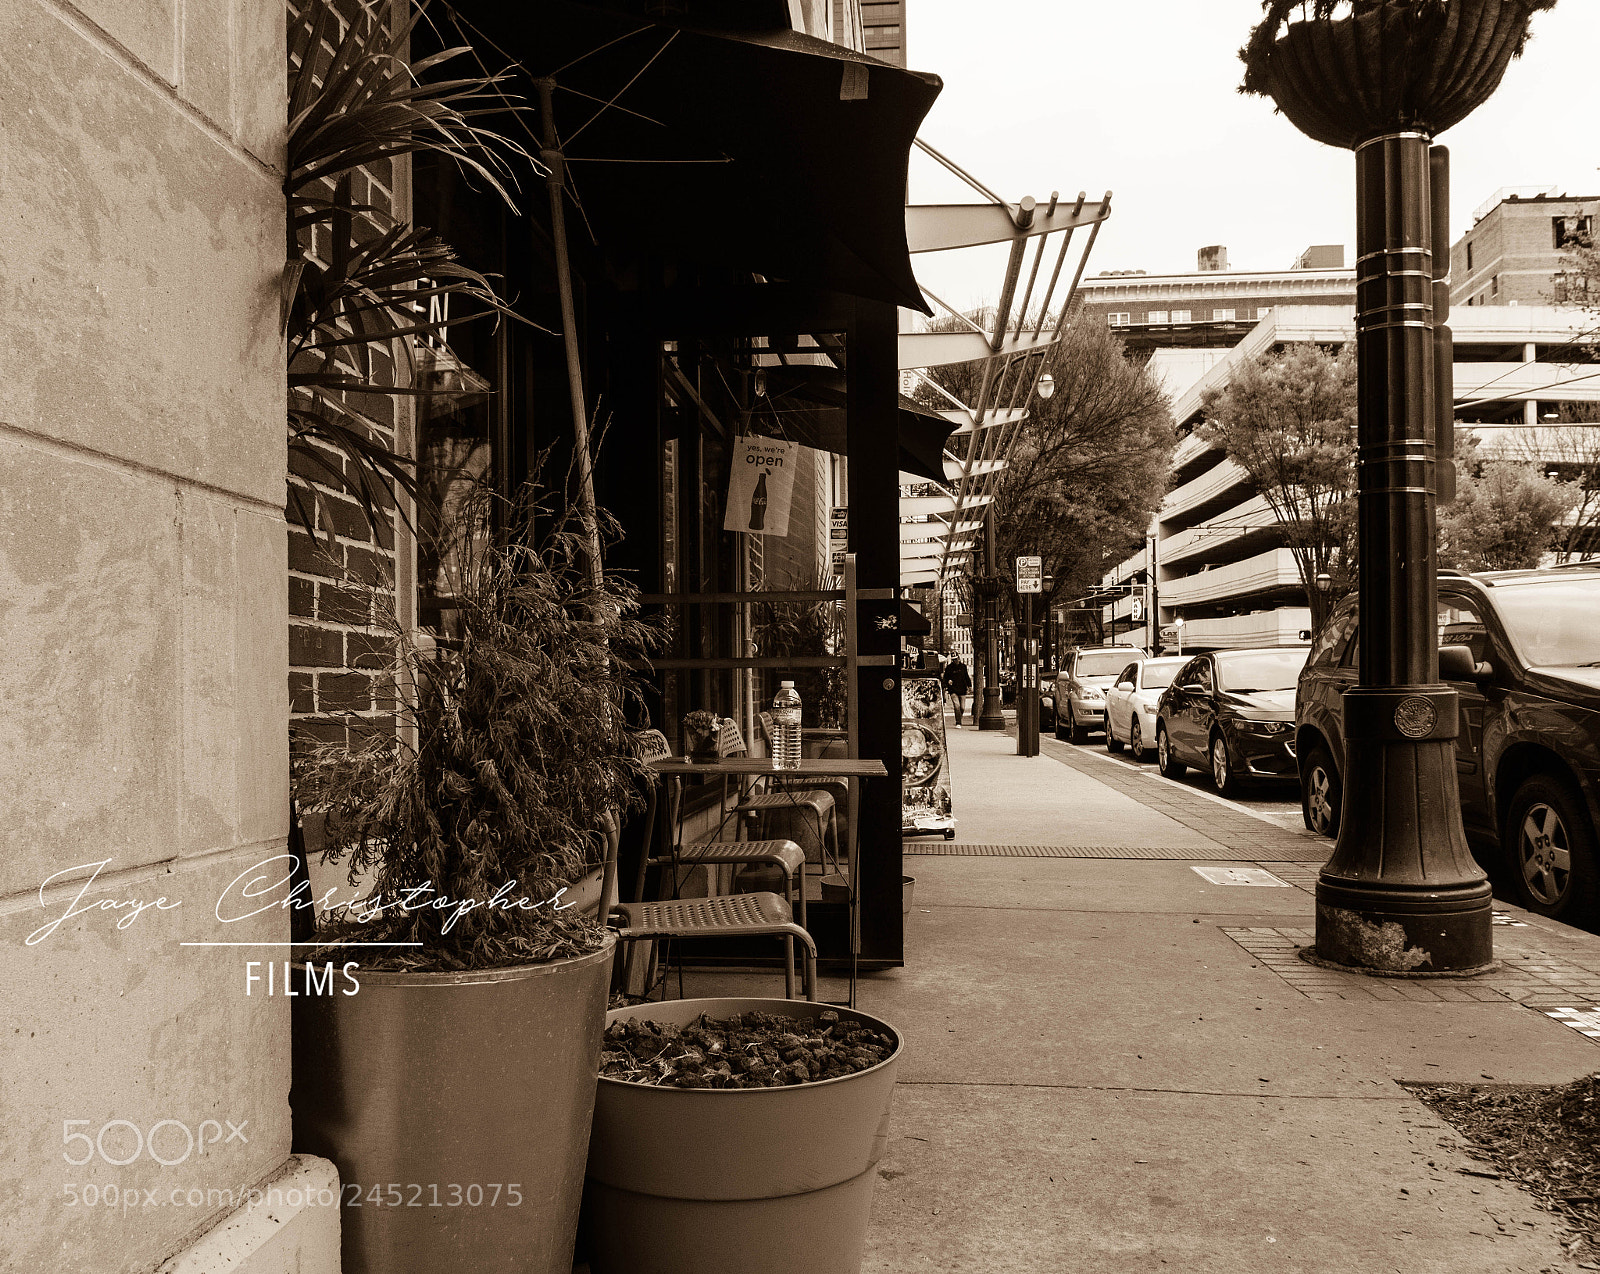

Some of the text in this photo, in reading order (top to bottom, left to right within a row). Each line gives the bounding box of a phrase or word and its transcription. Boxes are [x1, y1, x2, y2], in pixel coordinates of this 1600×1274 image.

[747, 445, 785, 454] yes, we're
[746, 454, 784, 467] open
[831, 520, 848, 528] VISA
